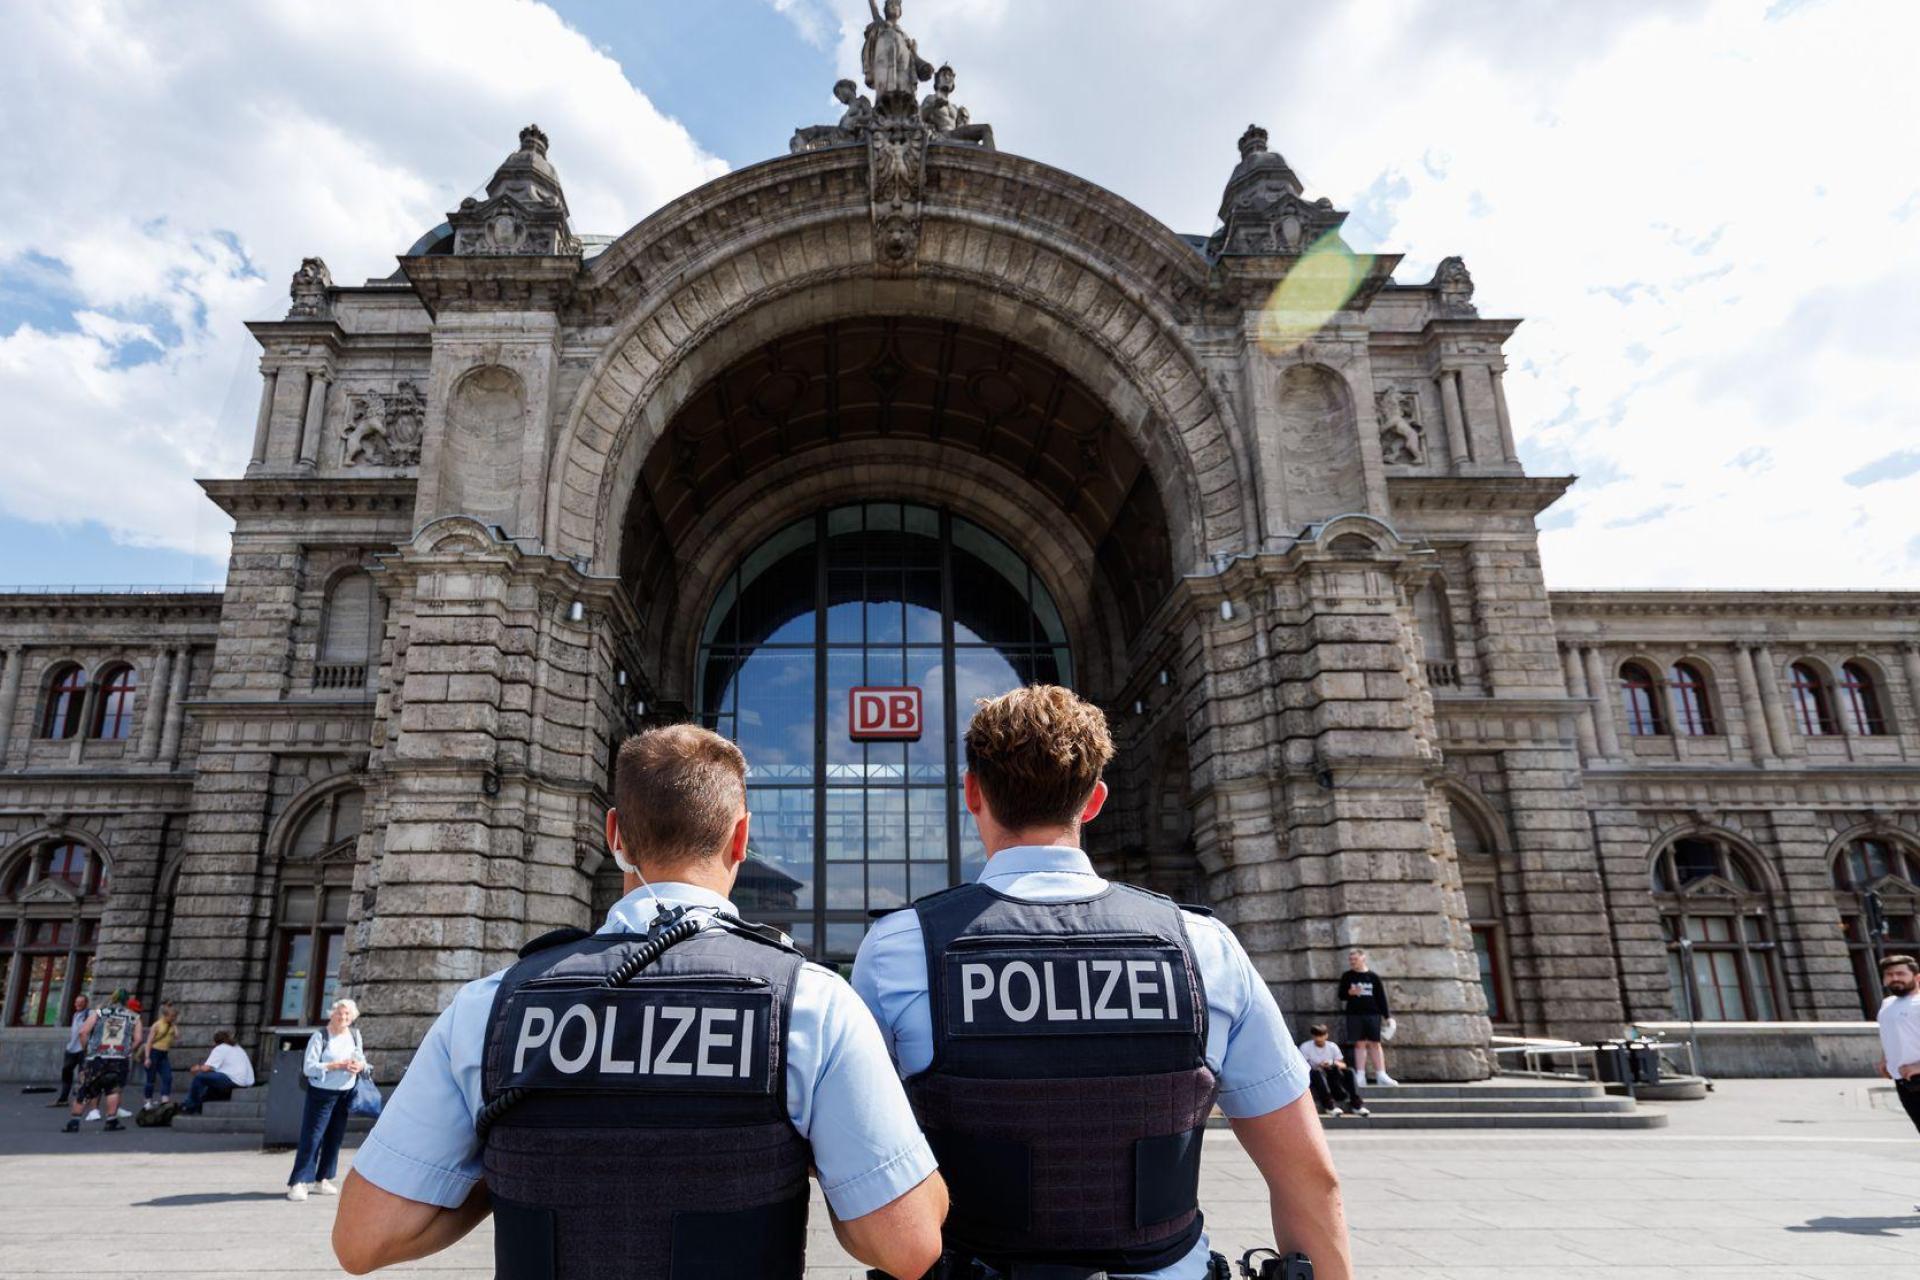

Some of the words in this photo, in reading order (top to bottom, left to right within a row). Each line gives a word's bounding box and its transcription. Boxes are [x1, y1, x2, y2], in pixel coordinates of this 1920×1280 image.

[860, 696, 916, 729] DB
[961, 959, 1179, 1023] POLIZEI
[512, 1003, 755, 1078] POLIZEI
